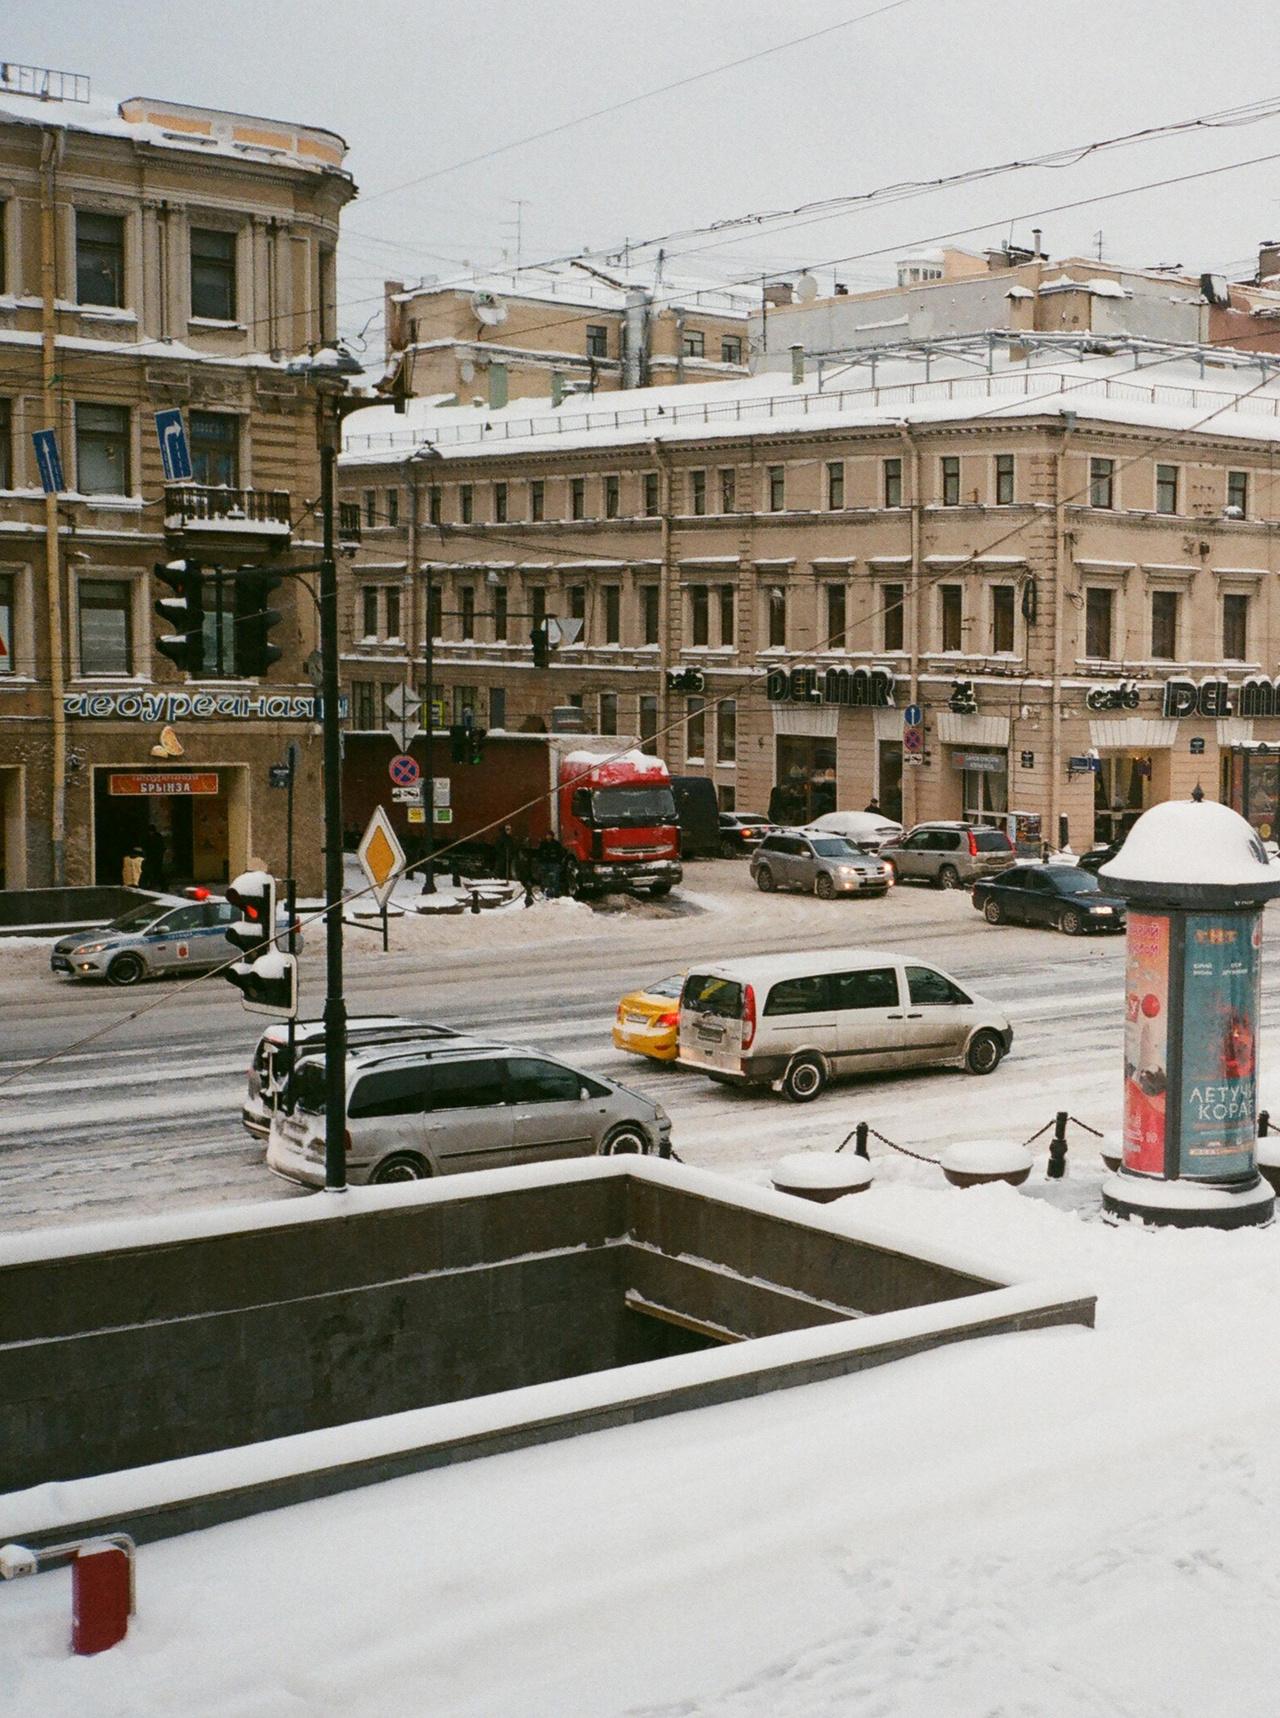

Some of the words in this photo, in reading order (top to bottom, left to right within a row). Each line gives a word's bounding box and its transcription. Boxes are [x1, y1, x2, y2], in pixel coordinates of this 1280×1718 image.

[767, 666, 822, 704] DEL
[825, 667, 895, 707] MAR
[1164, 678, 1232, 718] DEL
[63, 692, 315, 721] чебуречная
[140, 782, 195, 793] БРЫНЗА
[1195, 928, 1239, 946] ТНТ
